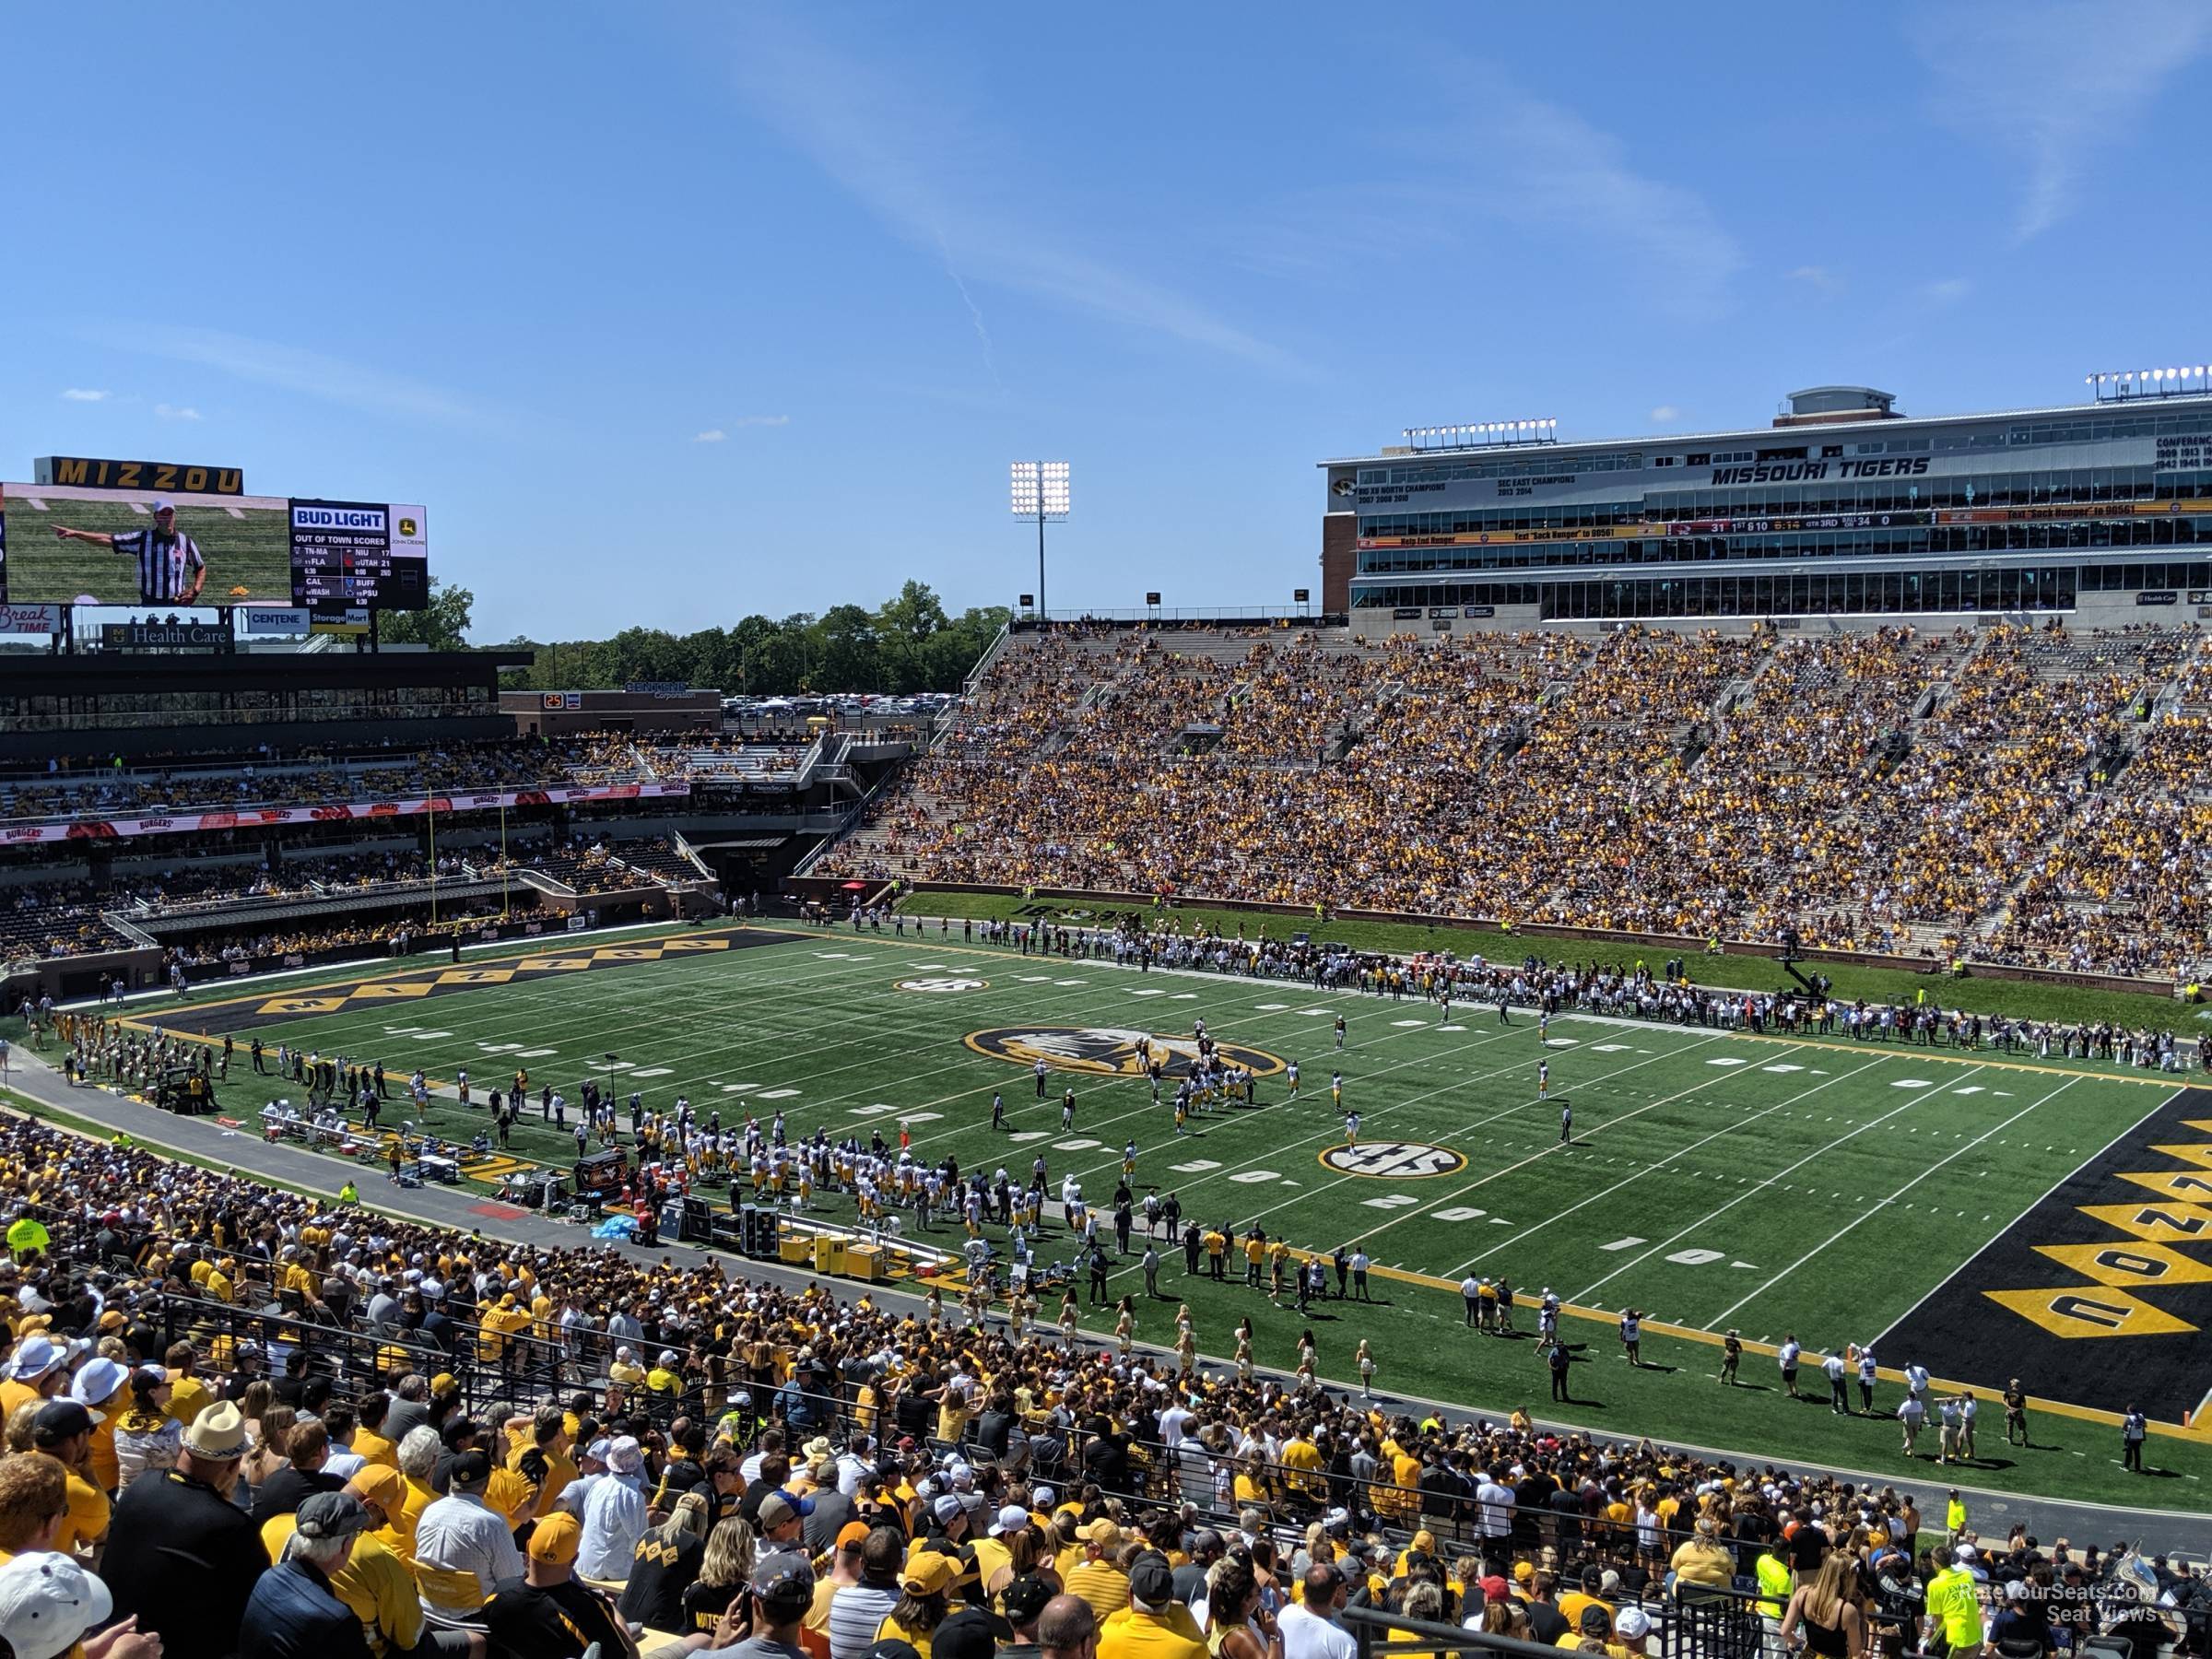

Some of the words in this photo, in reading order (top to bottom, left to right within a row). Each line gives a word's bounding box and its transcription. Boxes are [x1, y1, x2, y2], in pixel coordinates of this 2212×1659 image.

[58, 459, 241, 492] MIZZOU
[1712, 462, 1830, 485] MISSOURI
[1840, 457, 1931, 477] TIGERS
[1512, 478, 1531, 487] EAST
[1532, 476, 1575, 485] CHAMPIONS
[1381, 486, 1403, 494] NORTH
[1405, 483, 1445, 492] CHAMPIONS
[297, 510, 332, 525] BUD
[335, 512, 382, 527] LIGHT
[1820, 519, 1838, 527] 3RD
[1857, 516, 1870, 525] 34
[1882, 515, 1889, 524] 0
[1711, 524, 1724, 532] 31
[1756, 522, 1768, 531] 10
[295, 535, 312, 543] OUT
[315, 535, 325, 544] OF
[328, 536, 352, 545] TOWN
[354, 537, 385, 546] SCORES
[1430, 536, 1455, 546] Hunger
[0, 605, 53, 629] Break
[252, 614, 300, 625] CENTENE
[312, 613, 346, 623] Storage
[347, 613, 366, 622] Mart
[16, 622, 51, 633] TIME
[133, 627, 185, 643] Health
[190, 628, 227, 643] Care
[547, 695, 561, 707] 25
